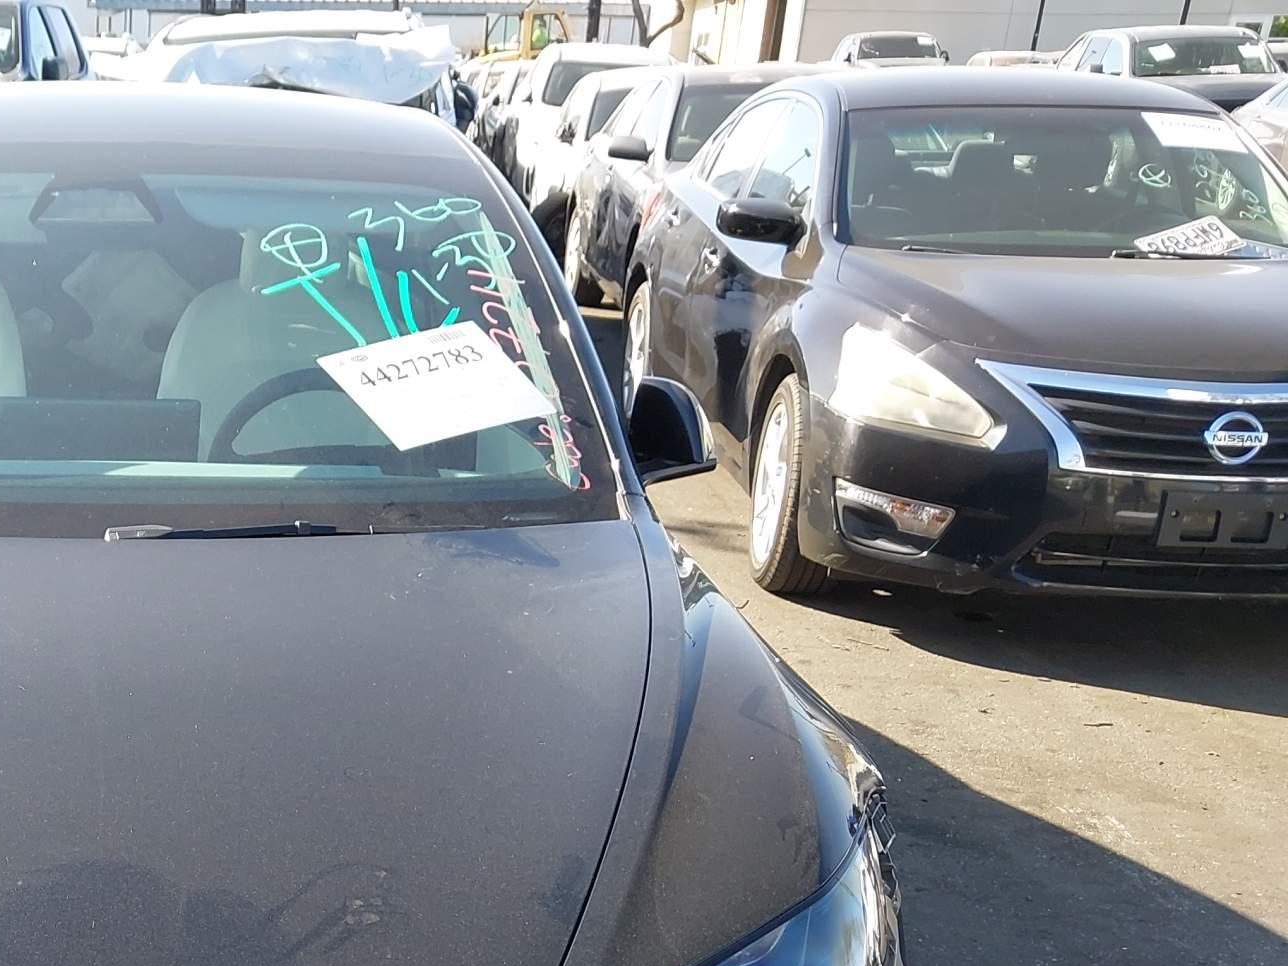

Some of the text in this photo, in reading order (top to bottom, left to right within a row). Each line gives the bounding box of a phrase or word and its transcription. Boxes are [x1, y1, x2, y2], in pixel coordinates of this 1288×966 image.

[348, 198, 482, 251] 360
[360, 345, 483, 387] 44272783
[1212, 433, 1264, 444] NISSAN
